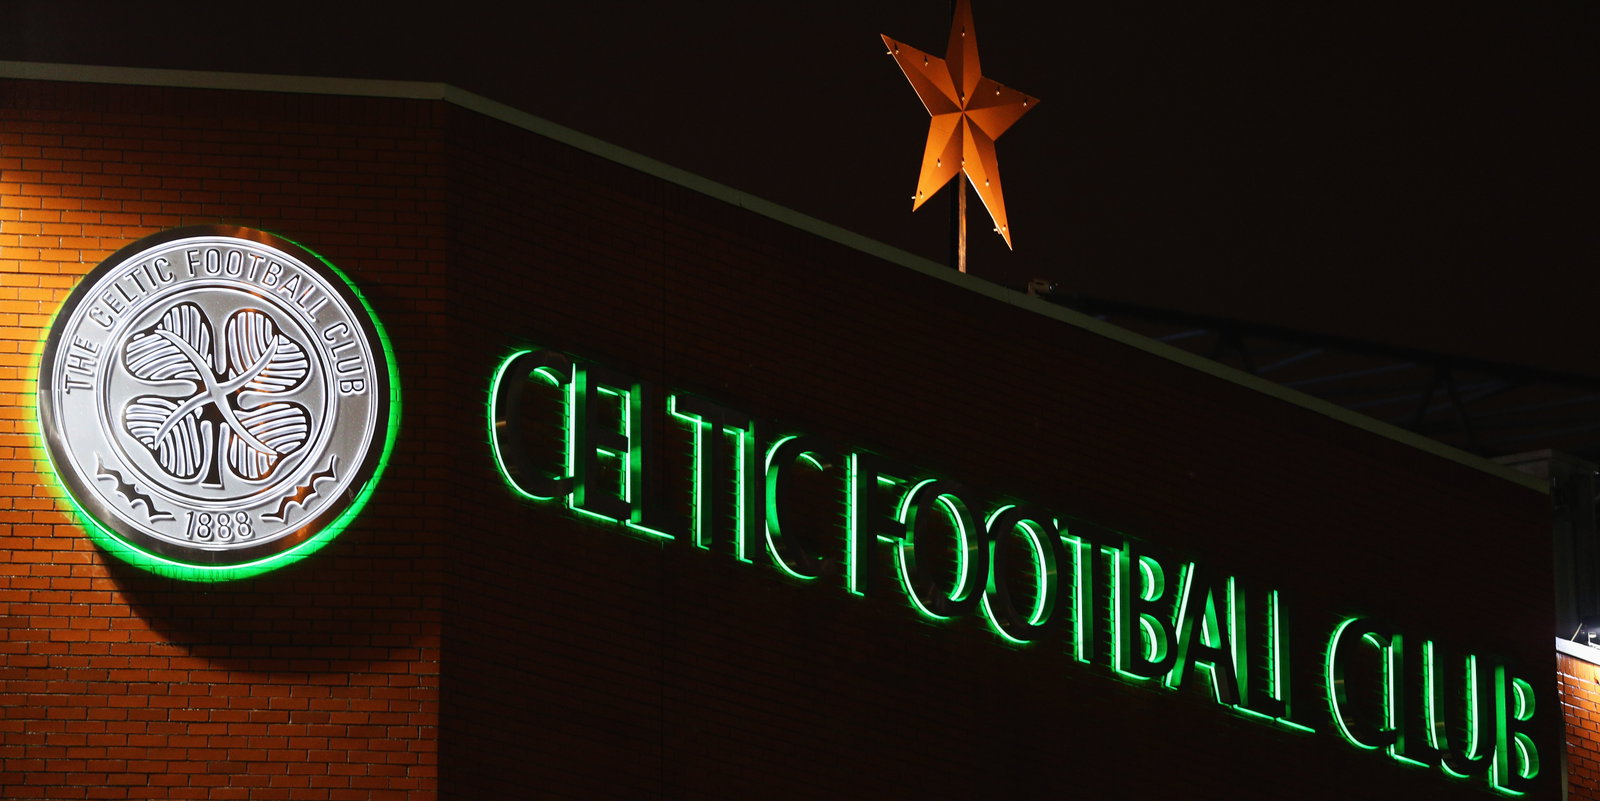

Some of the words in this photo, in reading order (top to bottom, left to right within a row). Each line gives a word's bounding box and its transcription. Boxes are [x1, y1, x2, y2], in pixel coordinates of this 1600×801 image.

[64, 335, 101, 395] THE
[89, 257, 176, 330] CELTIC
[186, 247, 329, 323] FOOTBALL
[322, 321, 366, 396] CLUB
[185, 511, 254, 541] 1888
[488, 347, 834, 582] CELTIC
[846, 450, 1318, 734] FOOTBALL
[1325, 615, 1540, 796] CLUB
